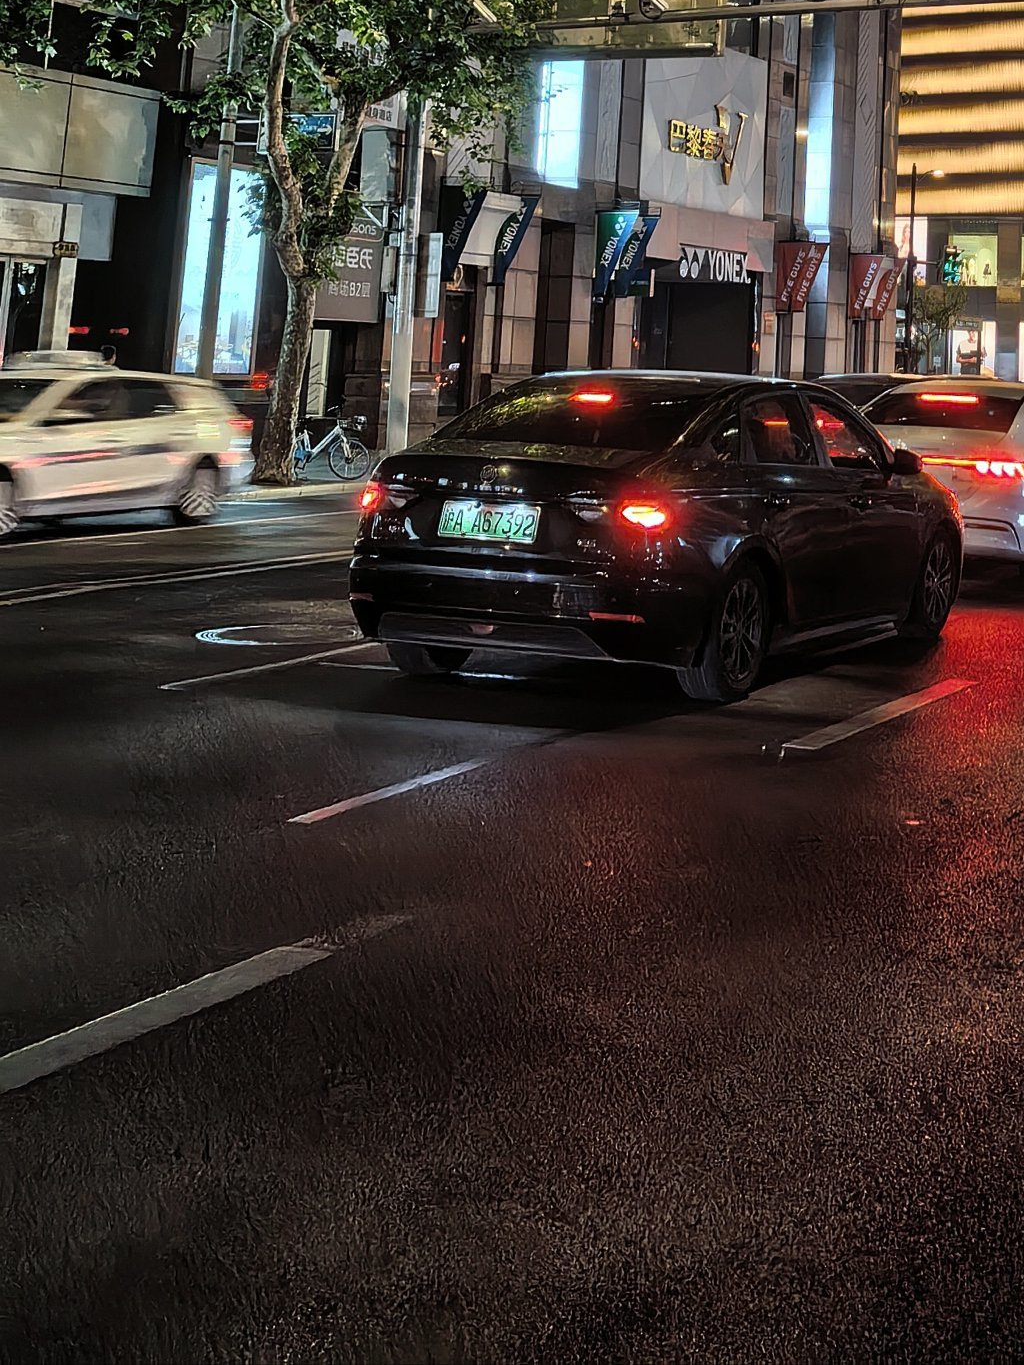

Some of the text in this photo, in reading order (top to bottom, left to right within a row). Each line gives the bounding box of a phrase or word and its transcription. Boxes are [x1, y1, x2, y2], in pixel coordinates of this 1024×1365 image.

[445, 214, 467, 250] YONEX
[498, 222, 520, 256] YONEX
[600, 236, 620, 268] YONEX
[620, 240, 640, 270] YONEX
[708, 249, 751, 284] YONEX
[854, 261, 878, 310] FIVE GUYS
[877, 265, 899, 312] FIVE GUYS
[471, 509, 536, 537] A67392
